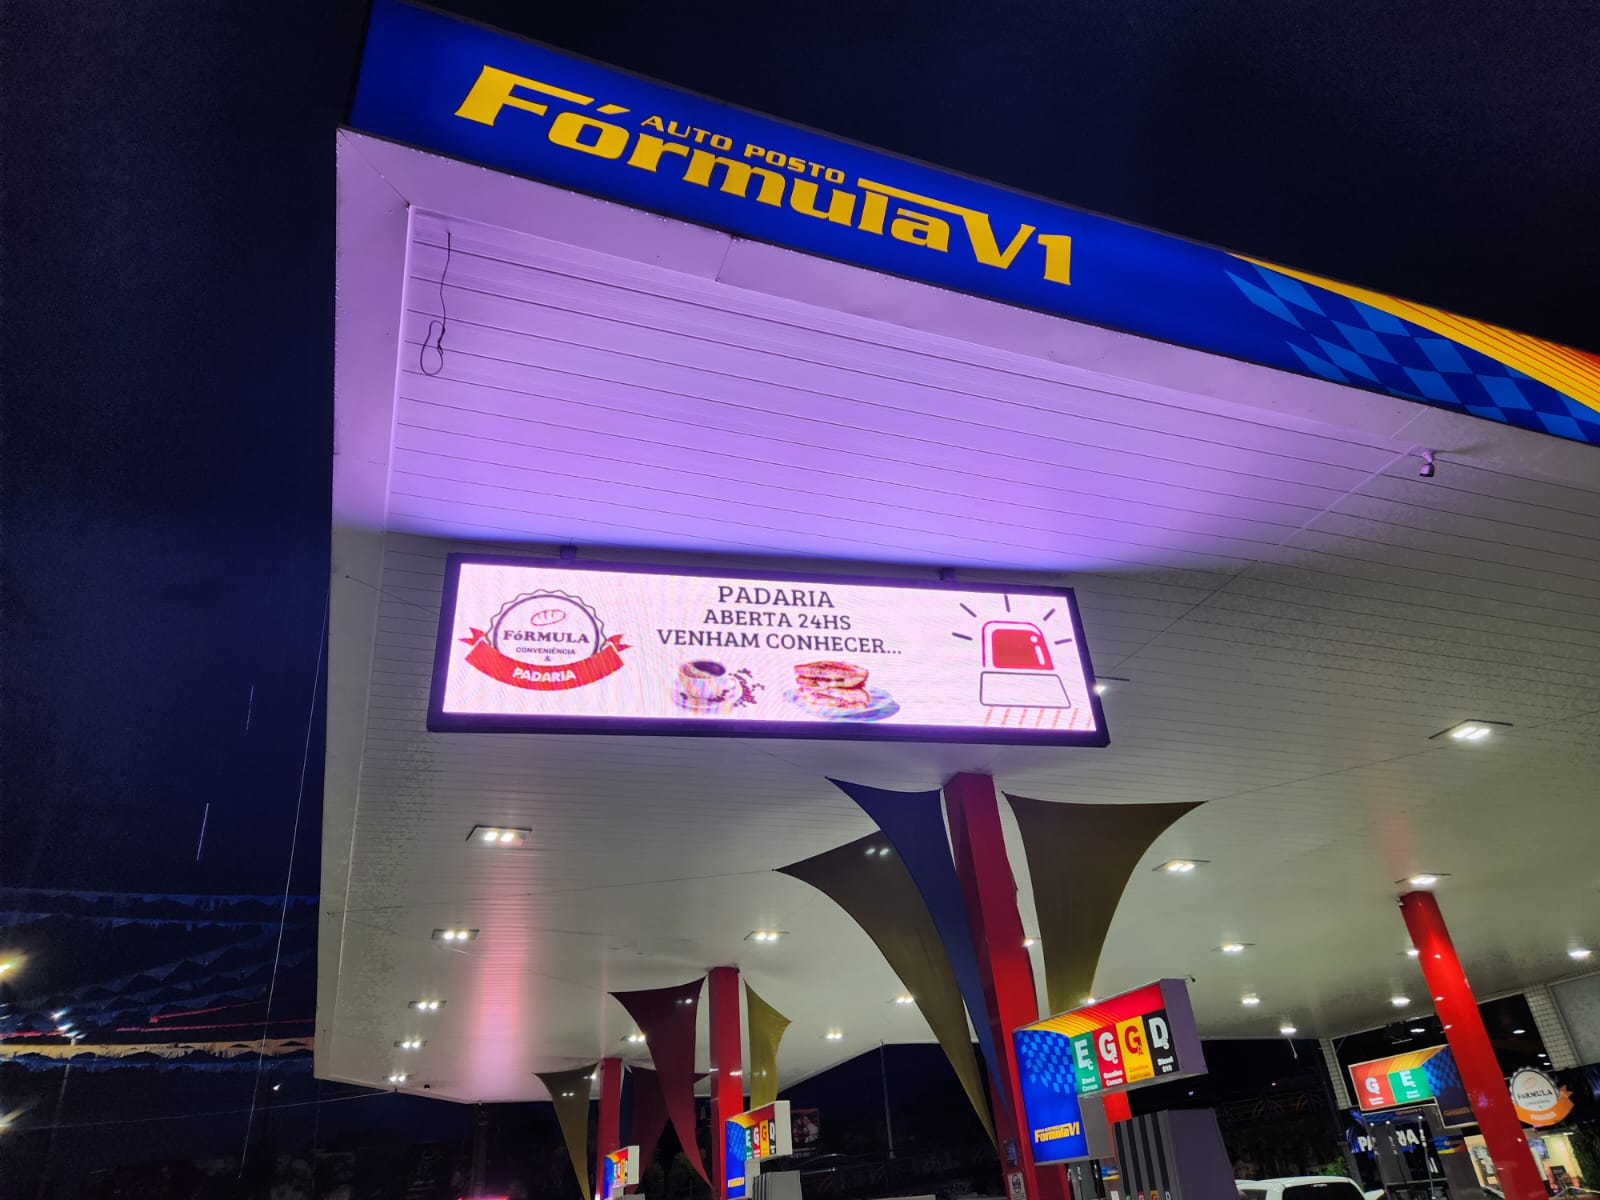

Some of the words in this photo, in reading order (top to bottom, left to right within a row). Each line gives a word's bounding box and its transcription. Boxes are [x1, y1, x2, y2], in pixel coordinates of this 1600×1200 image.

[640, 114, 734, 152] AUTO
[743, 142, 846, 184] POSTO
[717, 585, 835, 608] PADARIA
[703, 609, 793, 628] ABERTA
[797, 613, 852, 630] 24HS
[657, 629, 761, 648] VENHAM
[766, 633, 902, 654] CONHECER...
[512, 667, 576, 682] PADARIA
